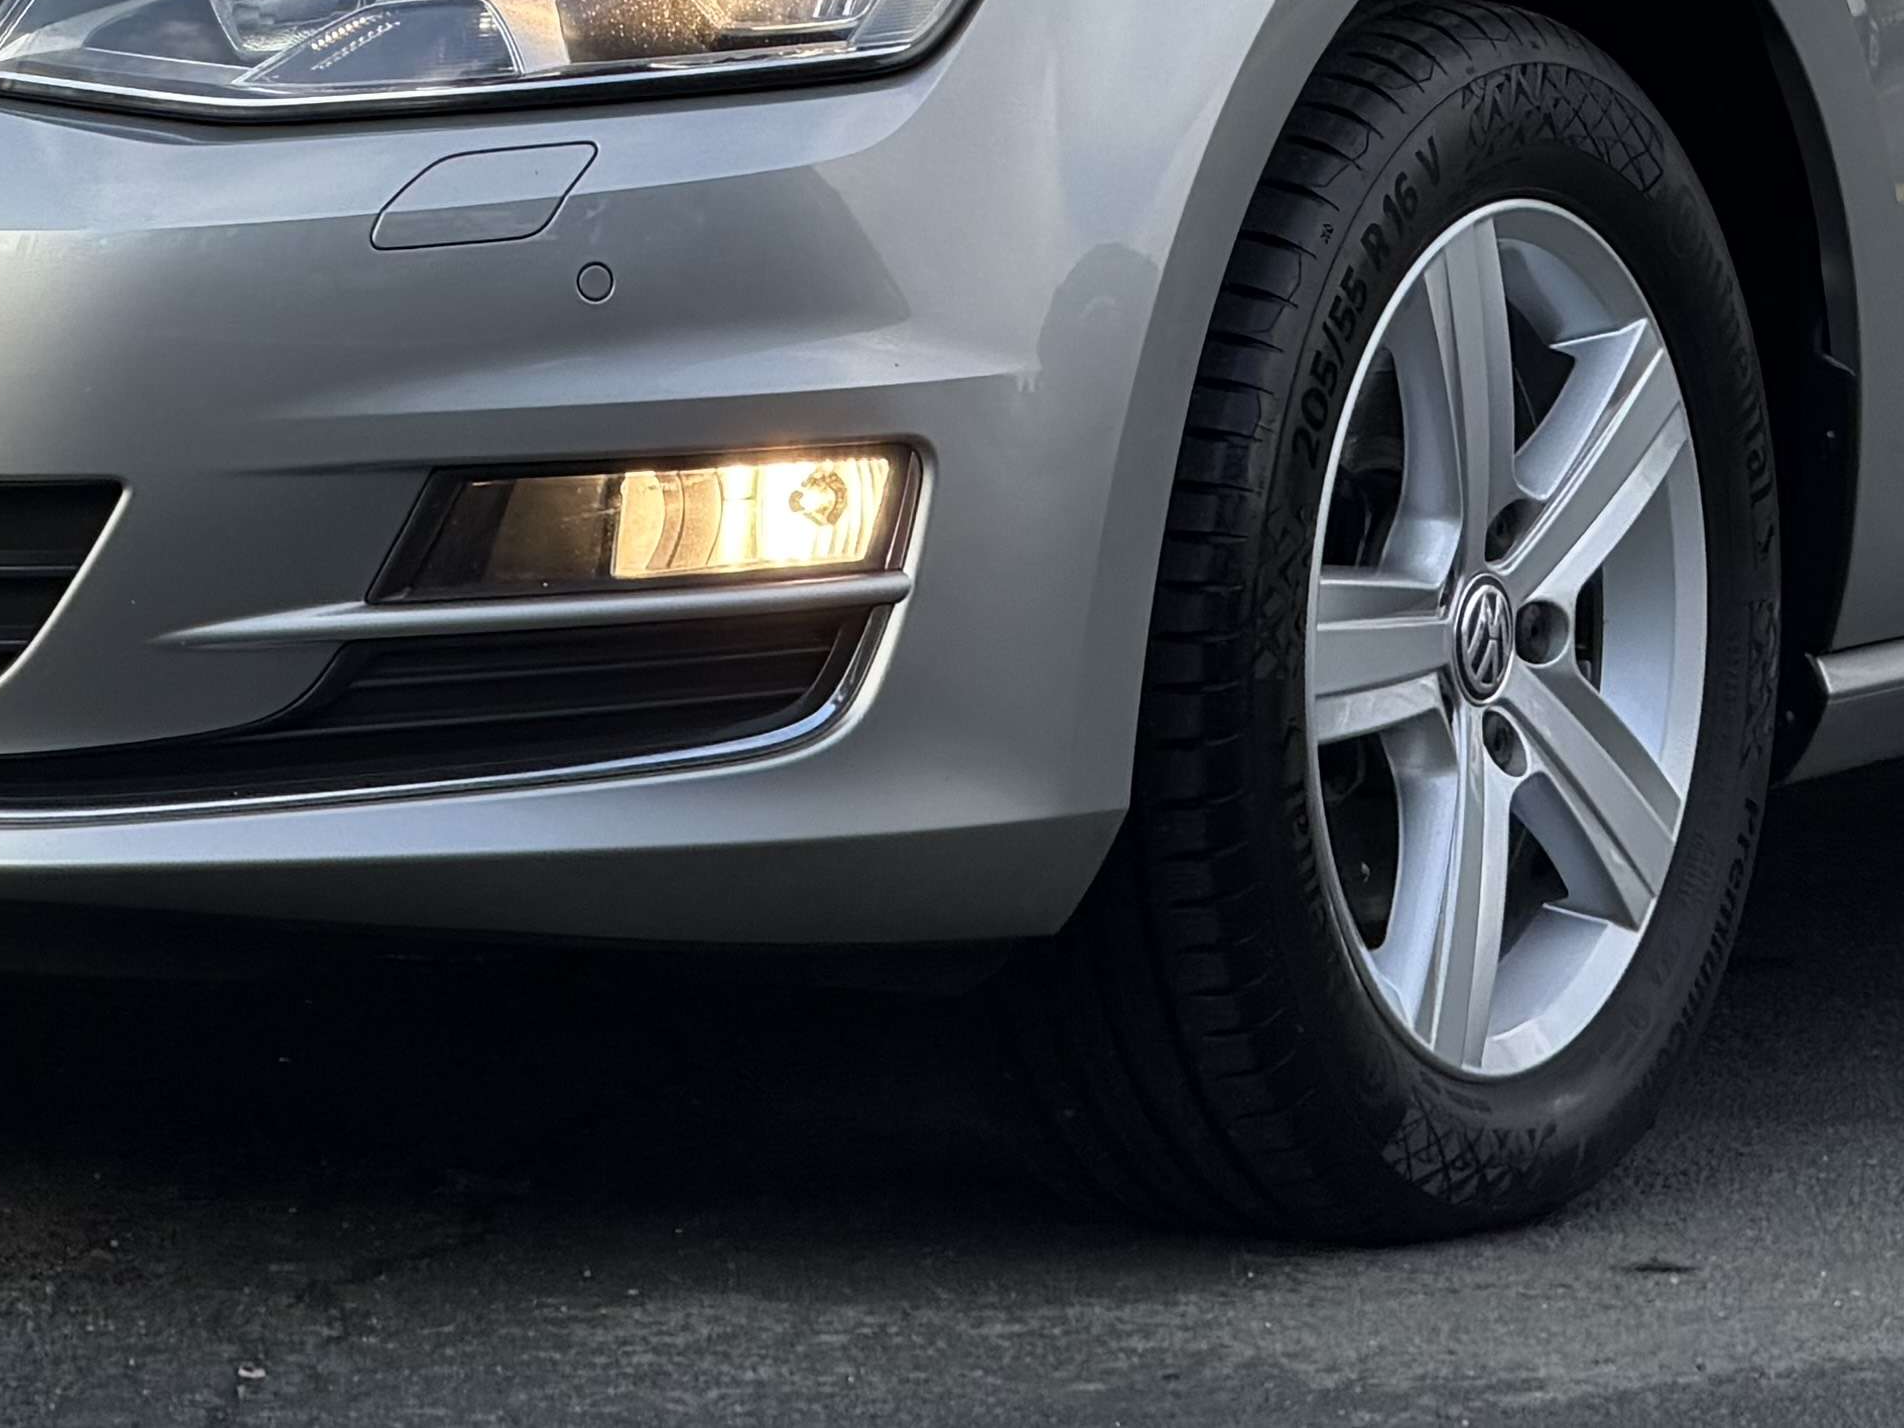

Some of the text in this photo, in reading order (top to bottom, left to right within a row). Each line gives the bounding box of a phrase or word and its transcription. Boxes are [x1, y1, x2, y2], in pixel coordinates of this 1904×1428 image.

[1291, 134, 1441, 470] 205/55 R 16 V
